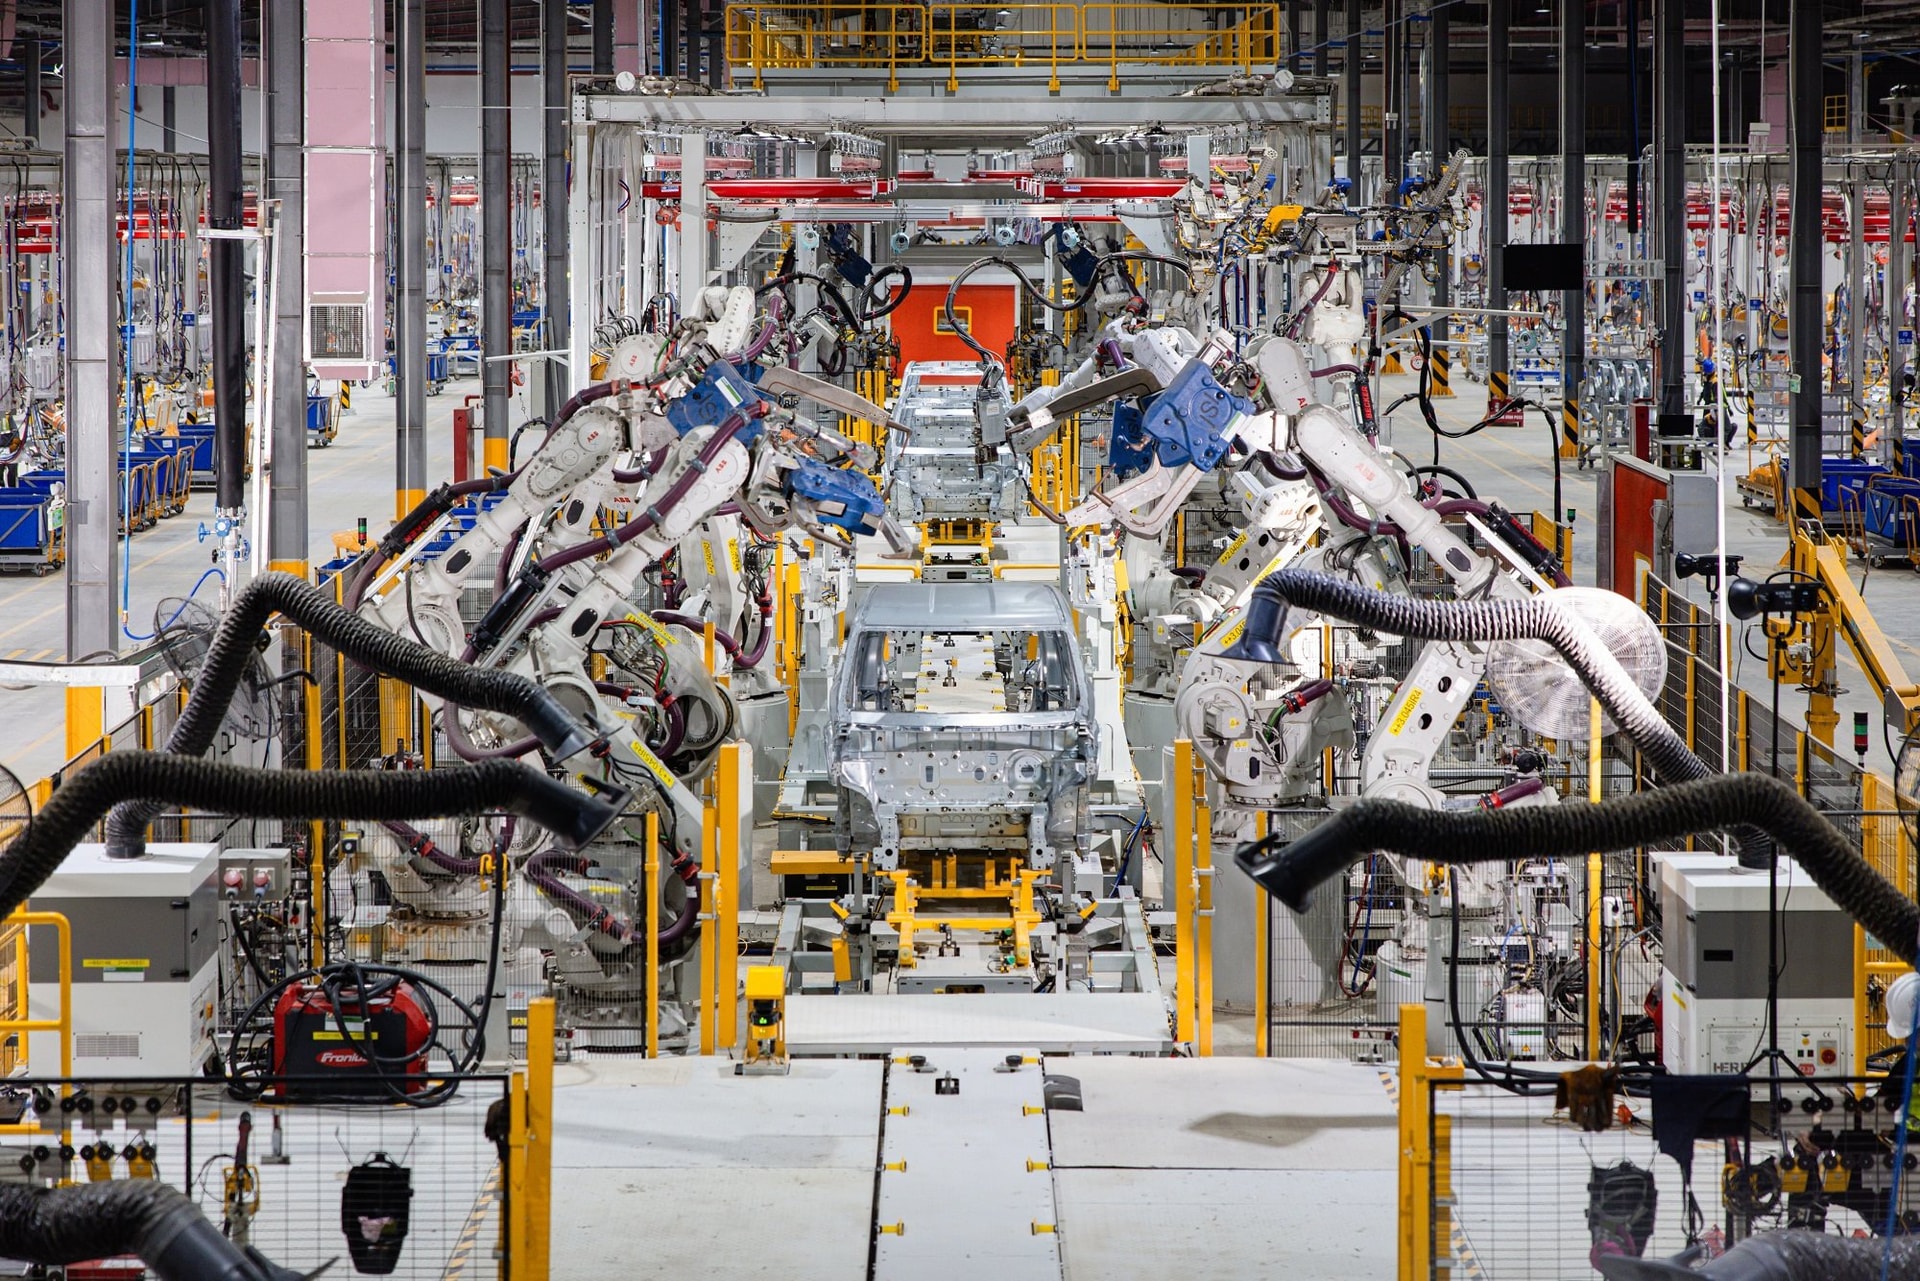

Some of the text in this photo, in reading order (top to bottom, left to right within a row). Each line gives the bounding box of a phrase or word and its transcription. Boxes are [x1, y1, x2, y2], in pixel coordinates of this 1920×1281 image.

[1361, 385, 1373, 419] BECKER
[586, 431, 600, 443] ABB
[715, 459, 727, 473] ABB
[1354, 463, 1376, 481] ABB
[404, 509, 440, 543] BECKER
[1392, 688, 1422, 734] ++3.045IR4
